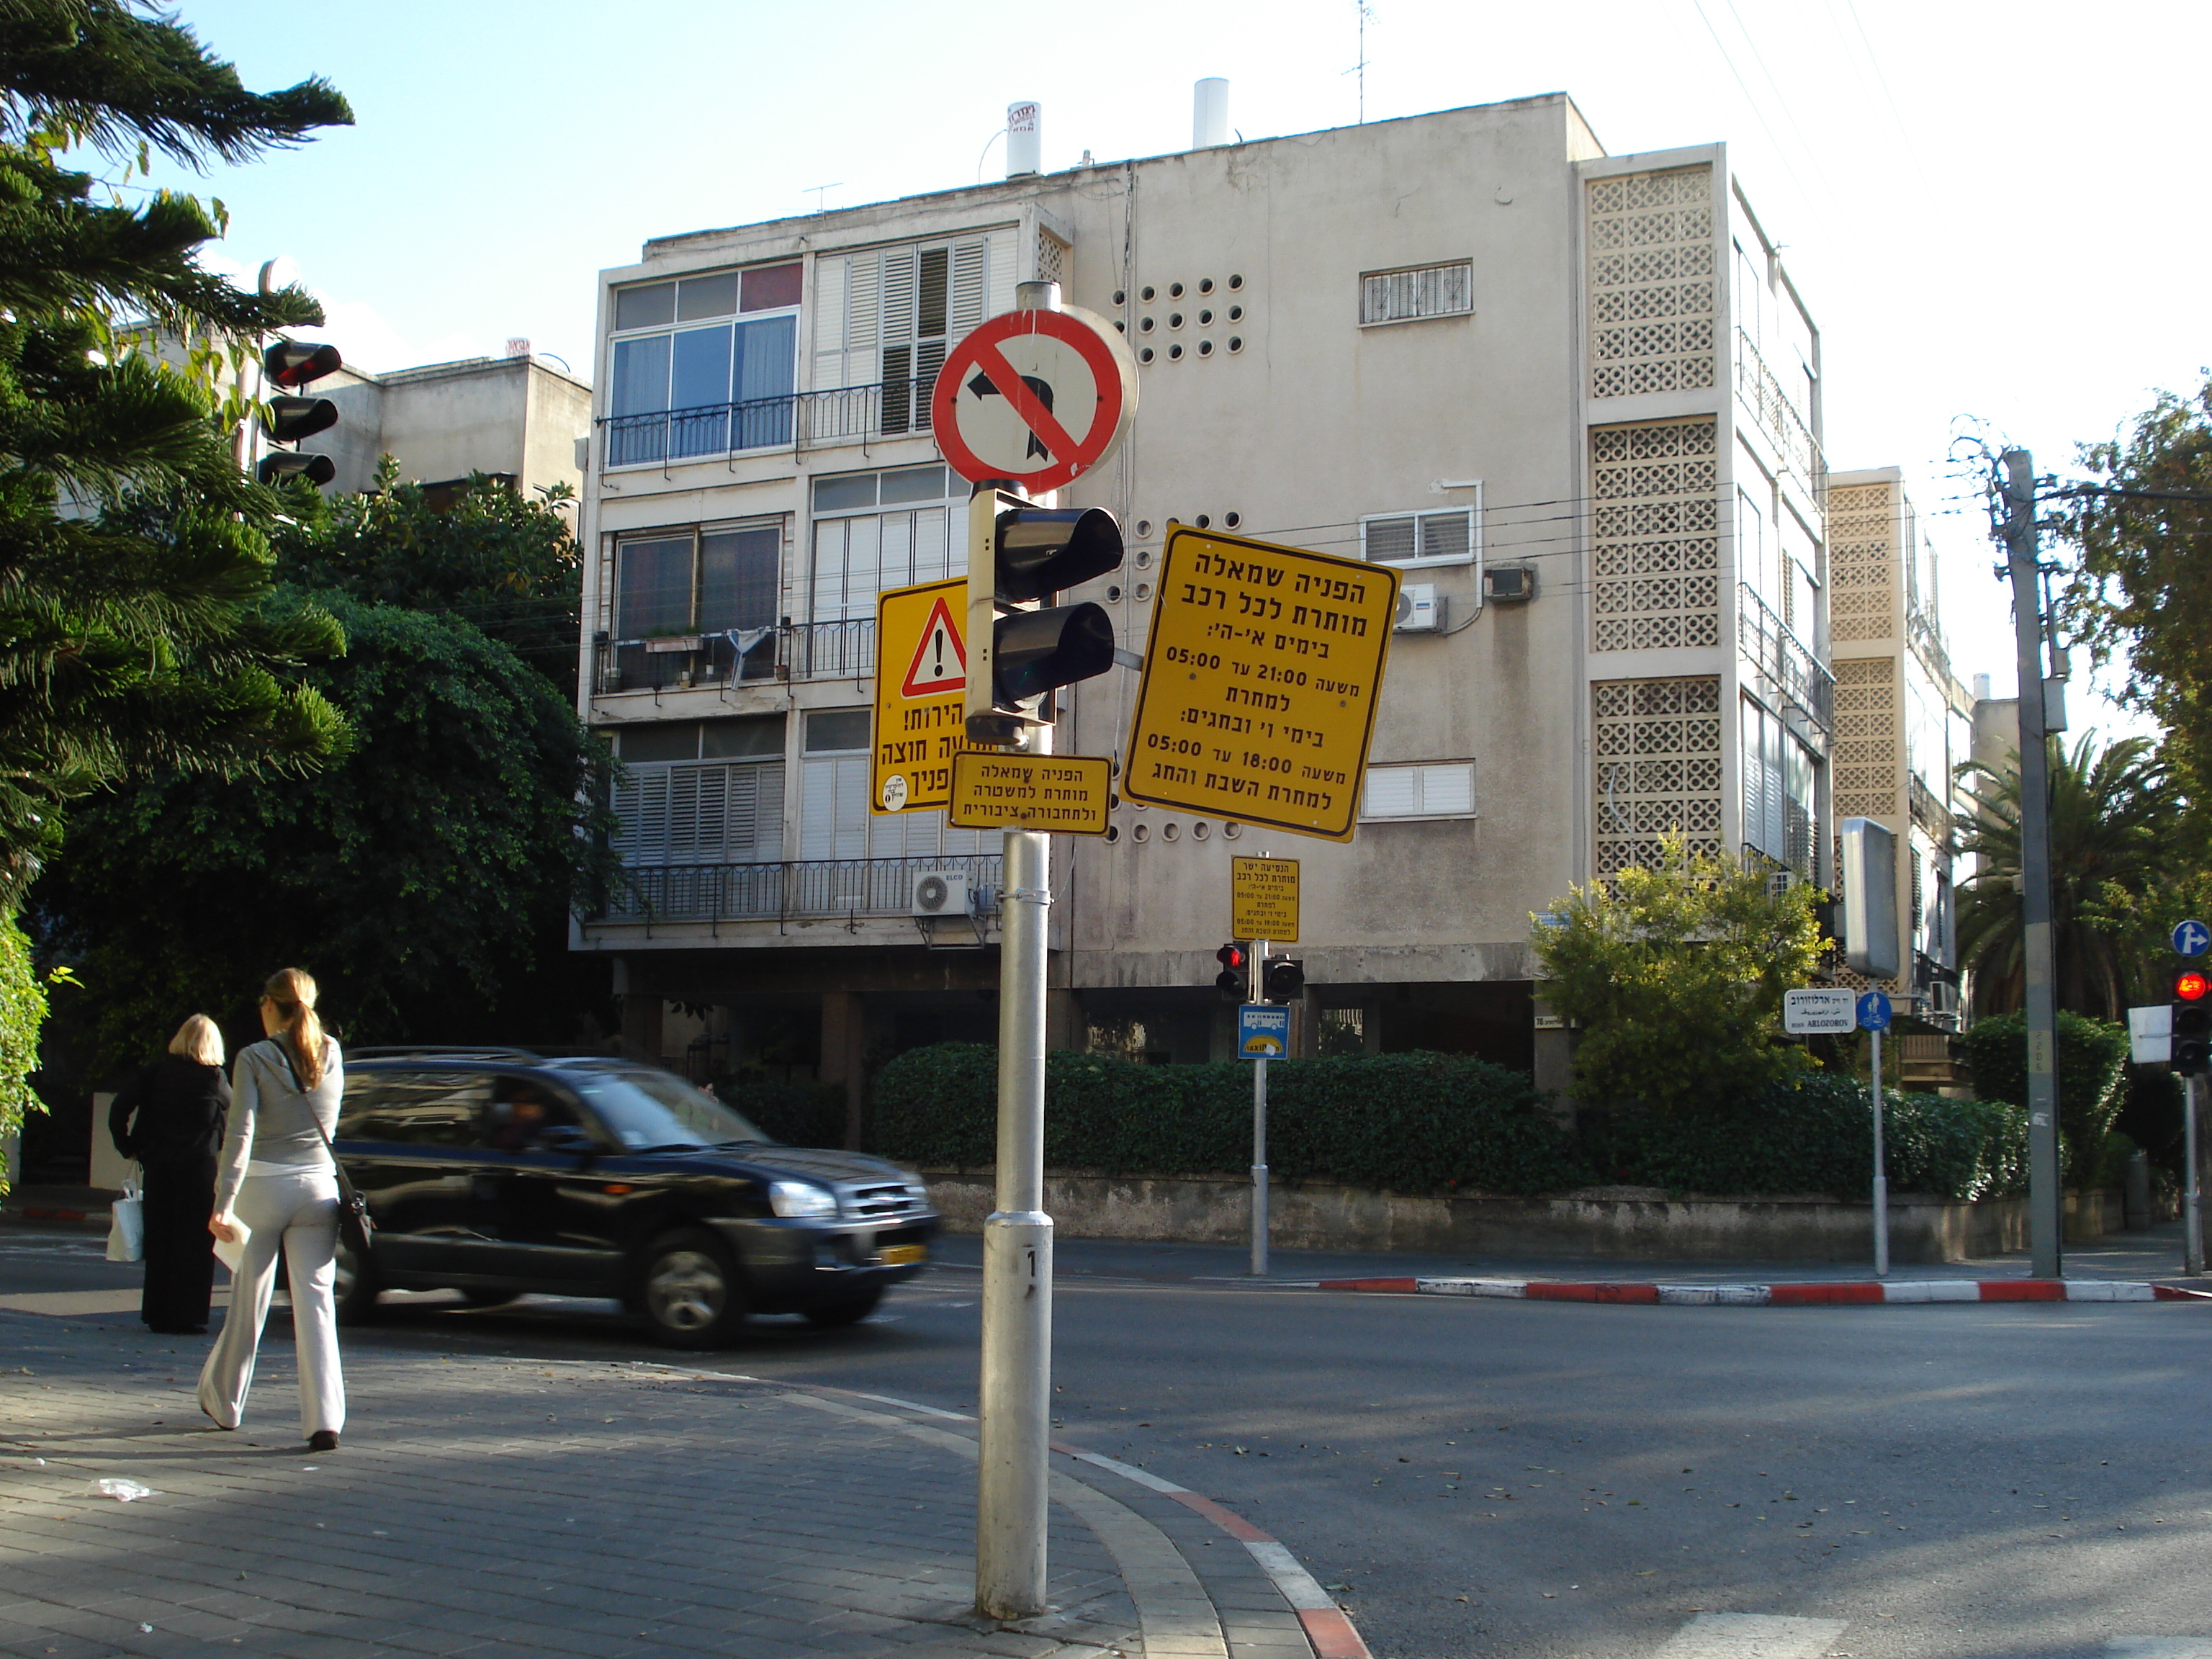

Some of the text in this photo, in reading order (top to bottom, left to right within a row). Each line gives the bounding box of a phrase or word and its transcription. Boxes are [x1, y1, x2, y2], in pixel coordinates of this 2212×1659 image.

[1195, 554, 1365, 604] הפניה שמאלה
[1182, 584, 1367, 637] מותרת לכל רכב
[1274, 634, 1329, 659] בימים
[1166, 647, 1359, 697] משעה 21:00 עד 05:00
[1226, 686, 1290, 711] למחרת
[904, 703, 963, 731] הירות!
[1180, 708, 1251, 734] ובחגים:
[1283, 726, 1323, 748] בימי
[882, 739, 927, 765] חוצה
[1147, 733, 1346, 785] משעה 18:00 עד 05:00
[911, 768, 948, 796] פניך
[981, 765, 1083, 781] הפניה שמאלה
[974, 785, 1088, 801] מותרת למשטרה
[1152, 763, 1331, 810] למחרת השבת והחג
[963, 804, 1096, 821] ולתחבורה ציבורית
[1236, 872, 1295, 884] מותרת לכל רכב
[1261, 863, 1289, 873] הנסיעה
[1791, 994, 1830, 1005] ארלוזורוב
[1808, 1019, 1849, 1028] ARLOZOROV
